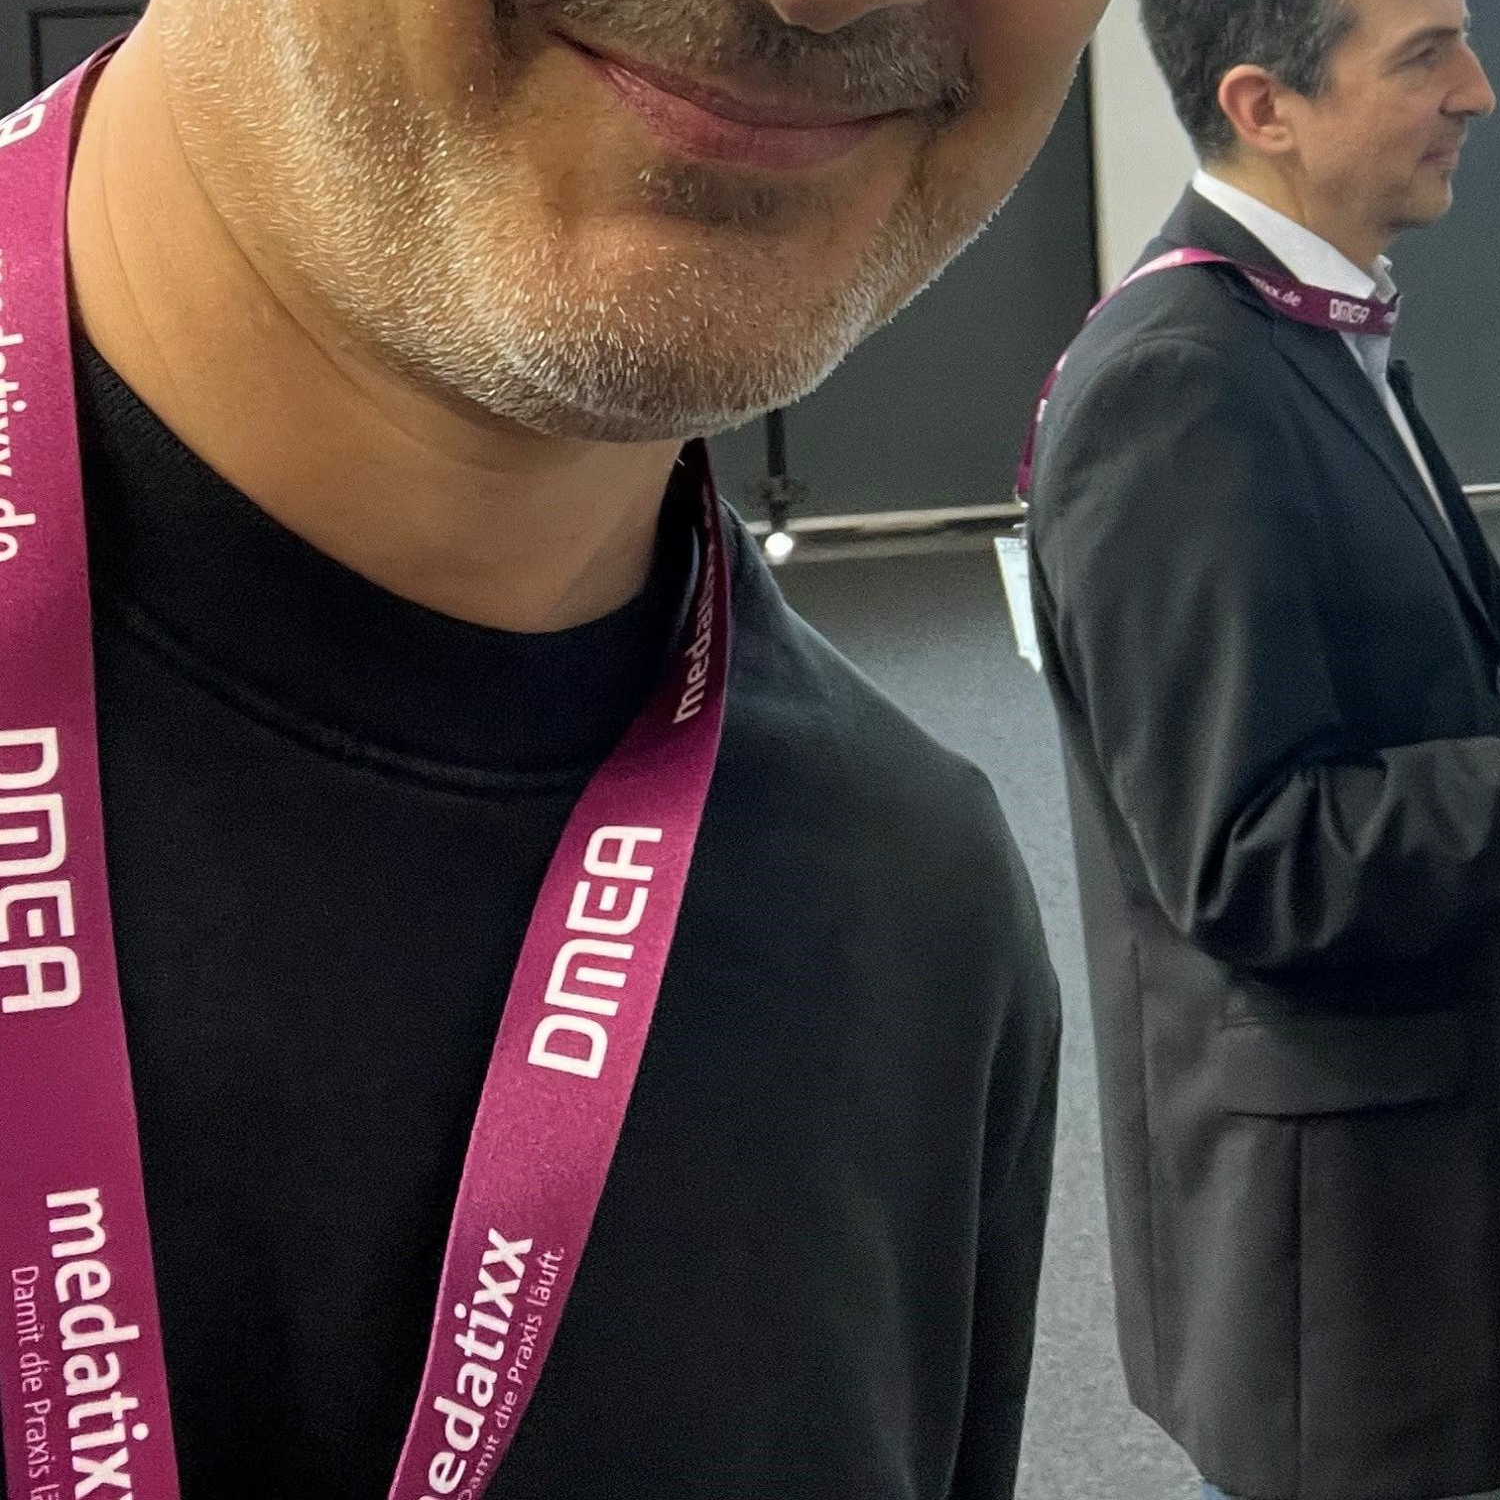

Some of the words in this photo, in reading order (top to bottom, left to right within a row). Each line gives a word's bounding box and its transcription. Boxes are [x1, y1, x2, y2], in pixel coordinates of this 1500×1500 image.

[1330, 298, 1370, 324] DMEA
[0, 727, 81, 1013] DMEA
[528, 826, 662, 1079] DMEA
[12, 1266, 45, 1346] Damit
[20, 1352, 50, 1393] die
[46, 1188, 149, 1500] medatix
[417, 1227, 533, 1500] edatixx
[494, 1391, 518, 1430] die
[506, 1313, 543, 1385] Praxis
[526, 1247, 565, 1307] läuft.
[24, 1399, 56, 1479] Praxis
